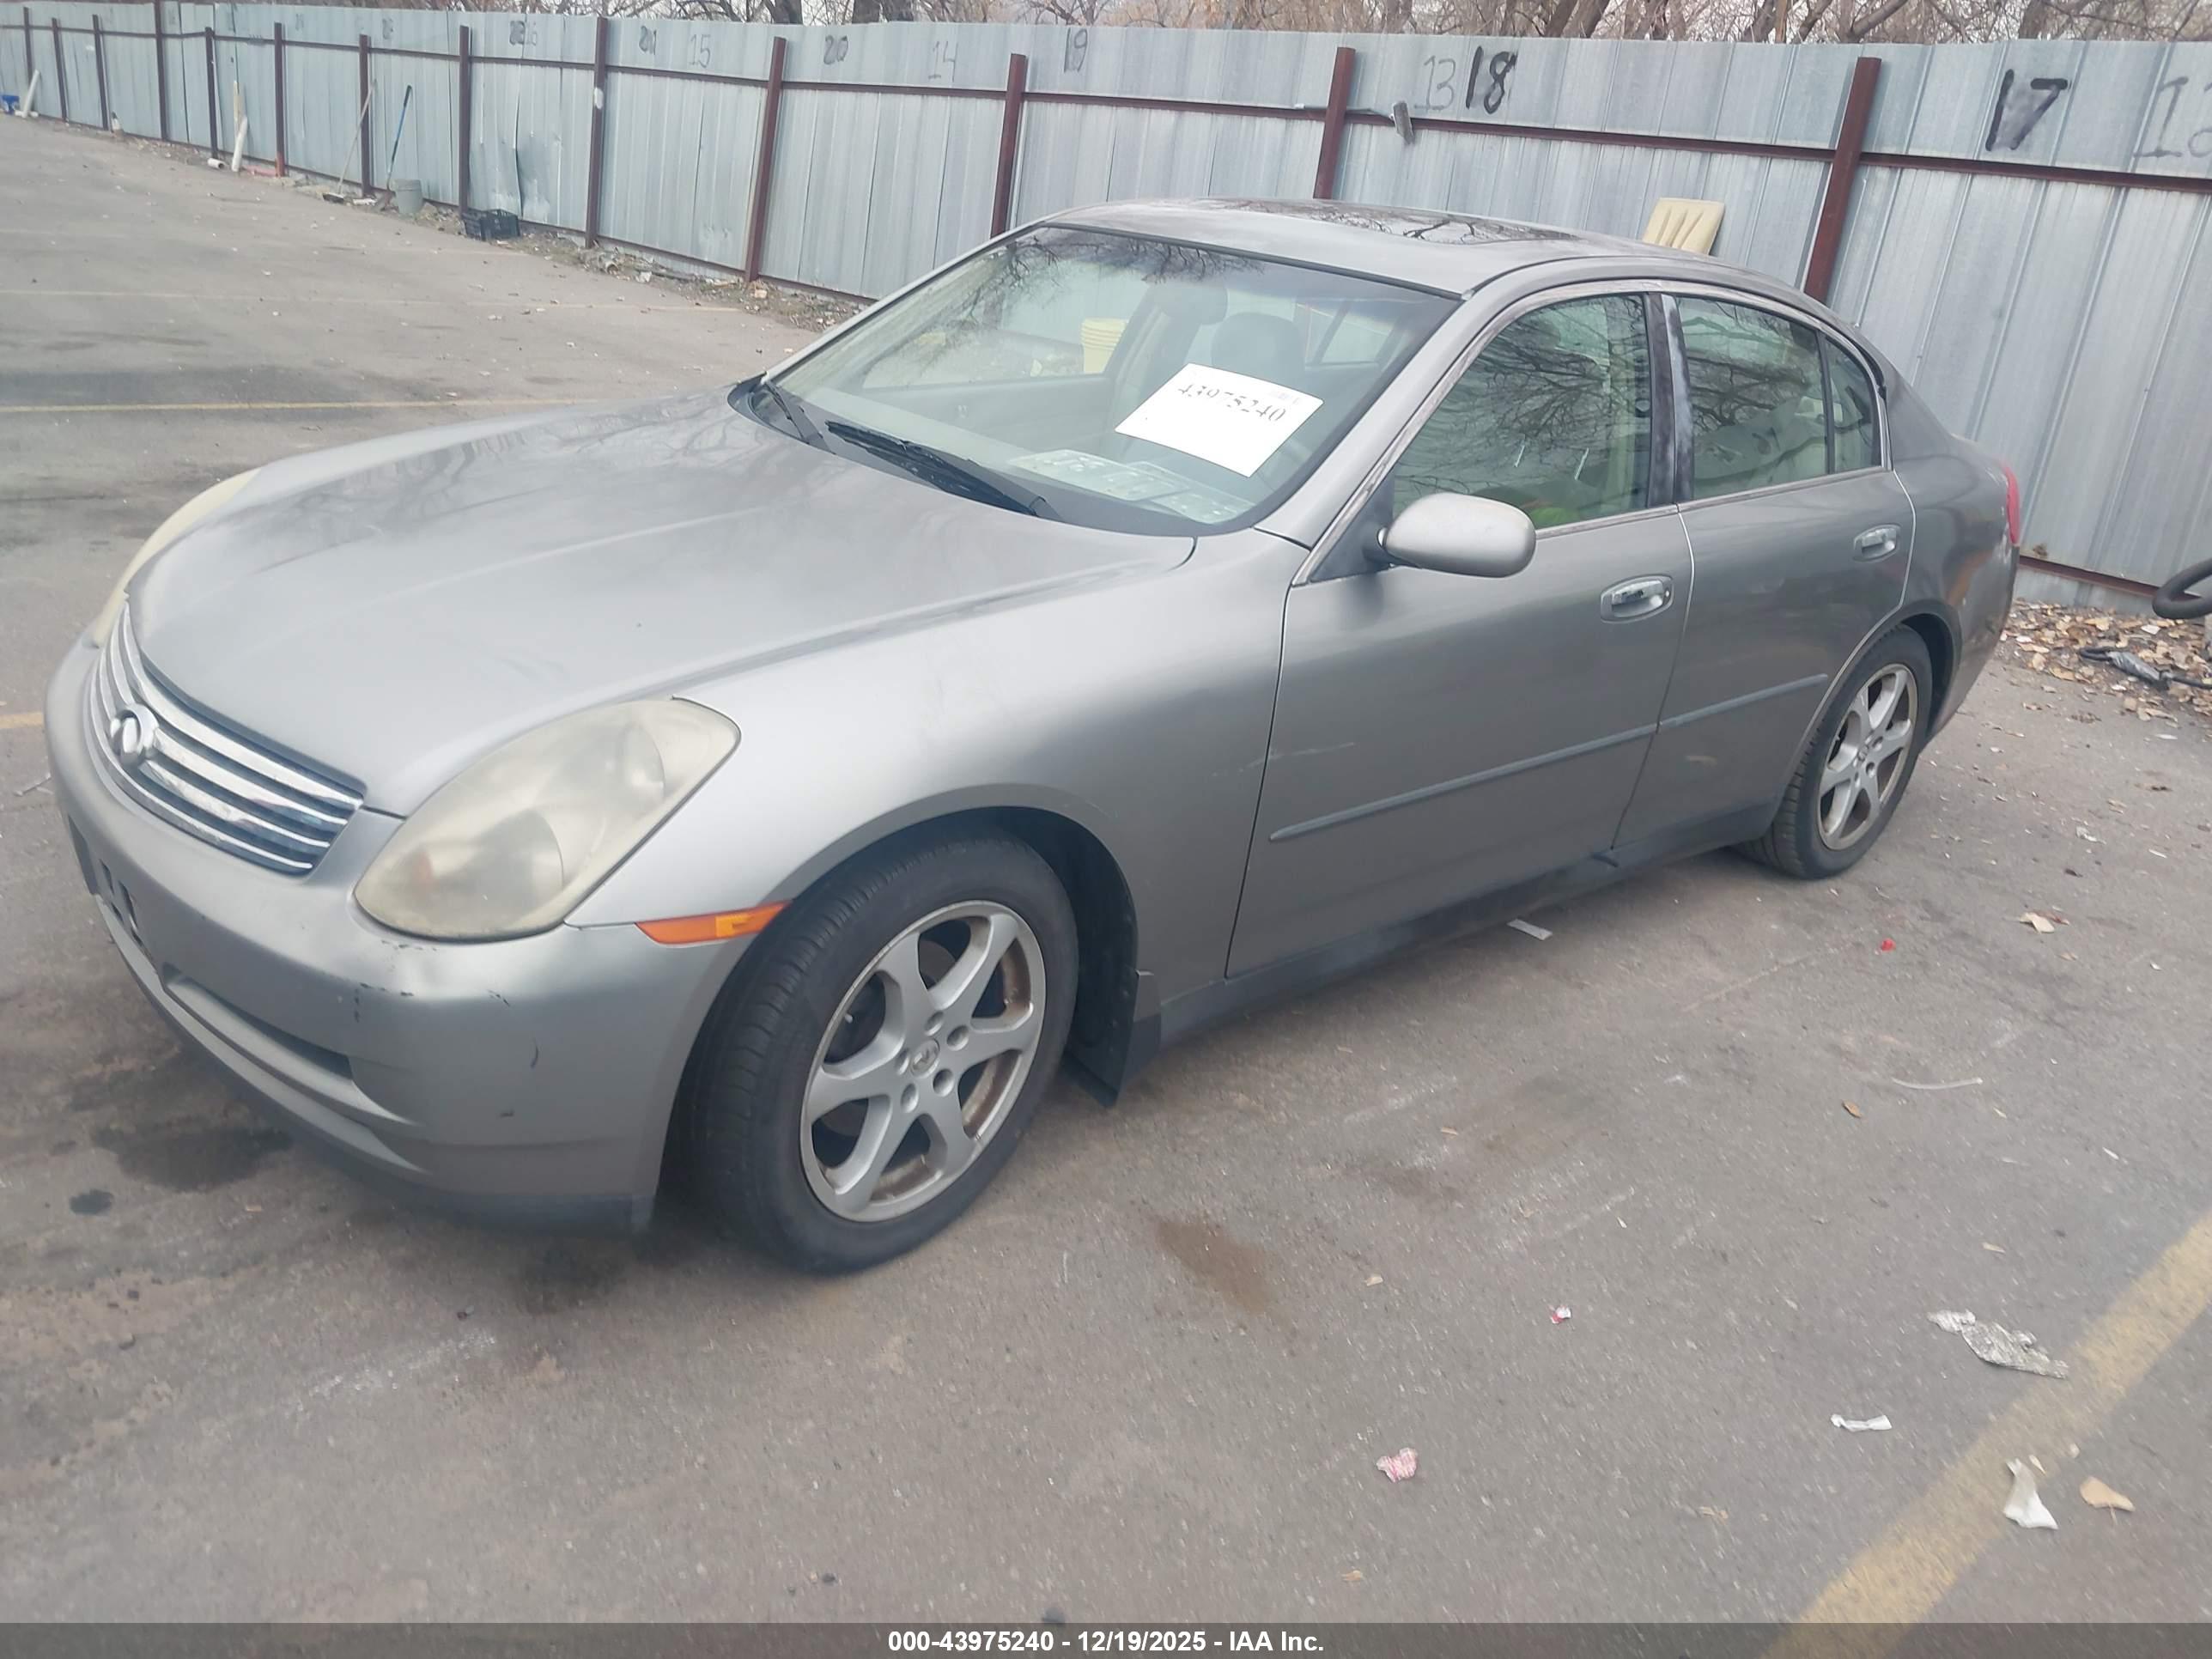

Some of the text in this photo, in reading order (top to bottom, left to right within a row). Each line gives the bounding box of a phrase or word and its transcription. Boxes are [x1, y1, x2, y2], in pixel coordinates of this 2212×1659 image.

[689, 33, 711, 69] 15
[823, 34, 849, 65] 20
[928, 40, 959, 82] 14
[1064, 27, 1088, 73] 19
[1413, 55, 1456, 112] 13
[1465, 46, 1516, 115] 18
[1985, 69, 2069, 151] 17
